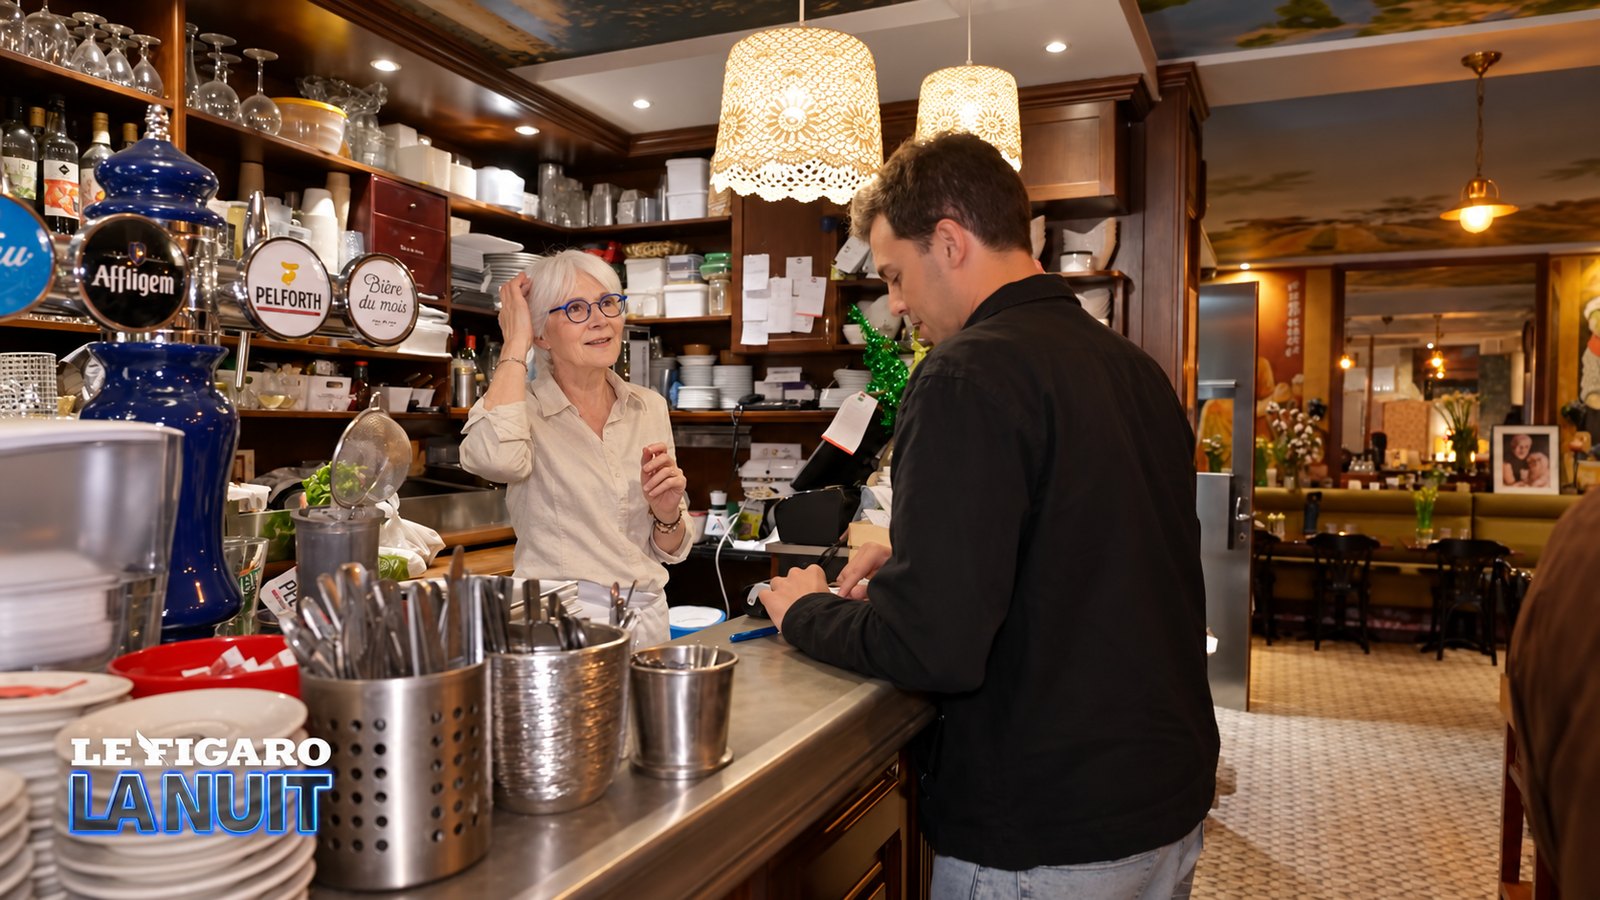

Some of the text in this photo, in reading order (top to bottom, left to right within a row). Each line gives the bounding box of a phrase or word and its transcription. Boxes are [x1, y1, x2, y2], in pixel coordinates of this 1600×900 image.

[91, 264, 175, 297] Affligem
[256, 286, 322, 310] PELFORTH
[359, 294, 407, 314] du mois
